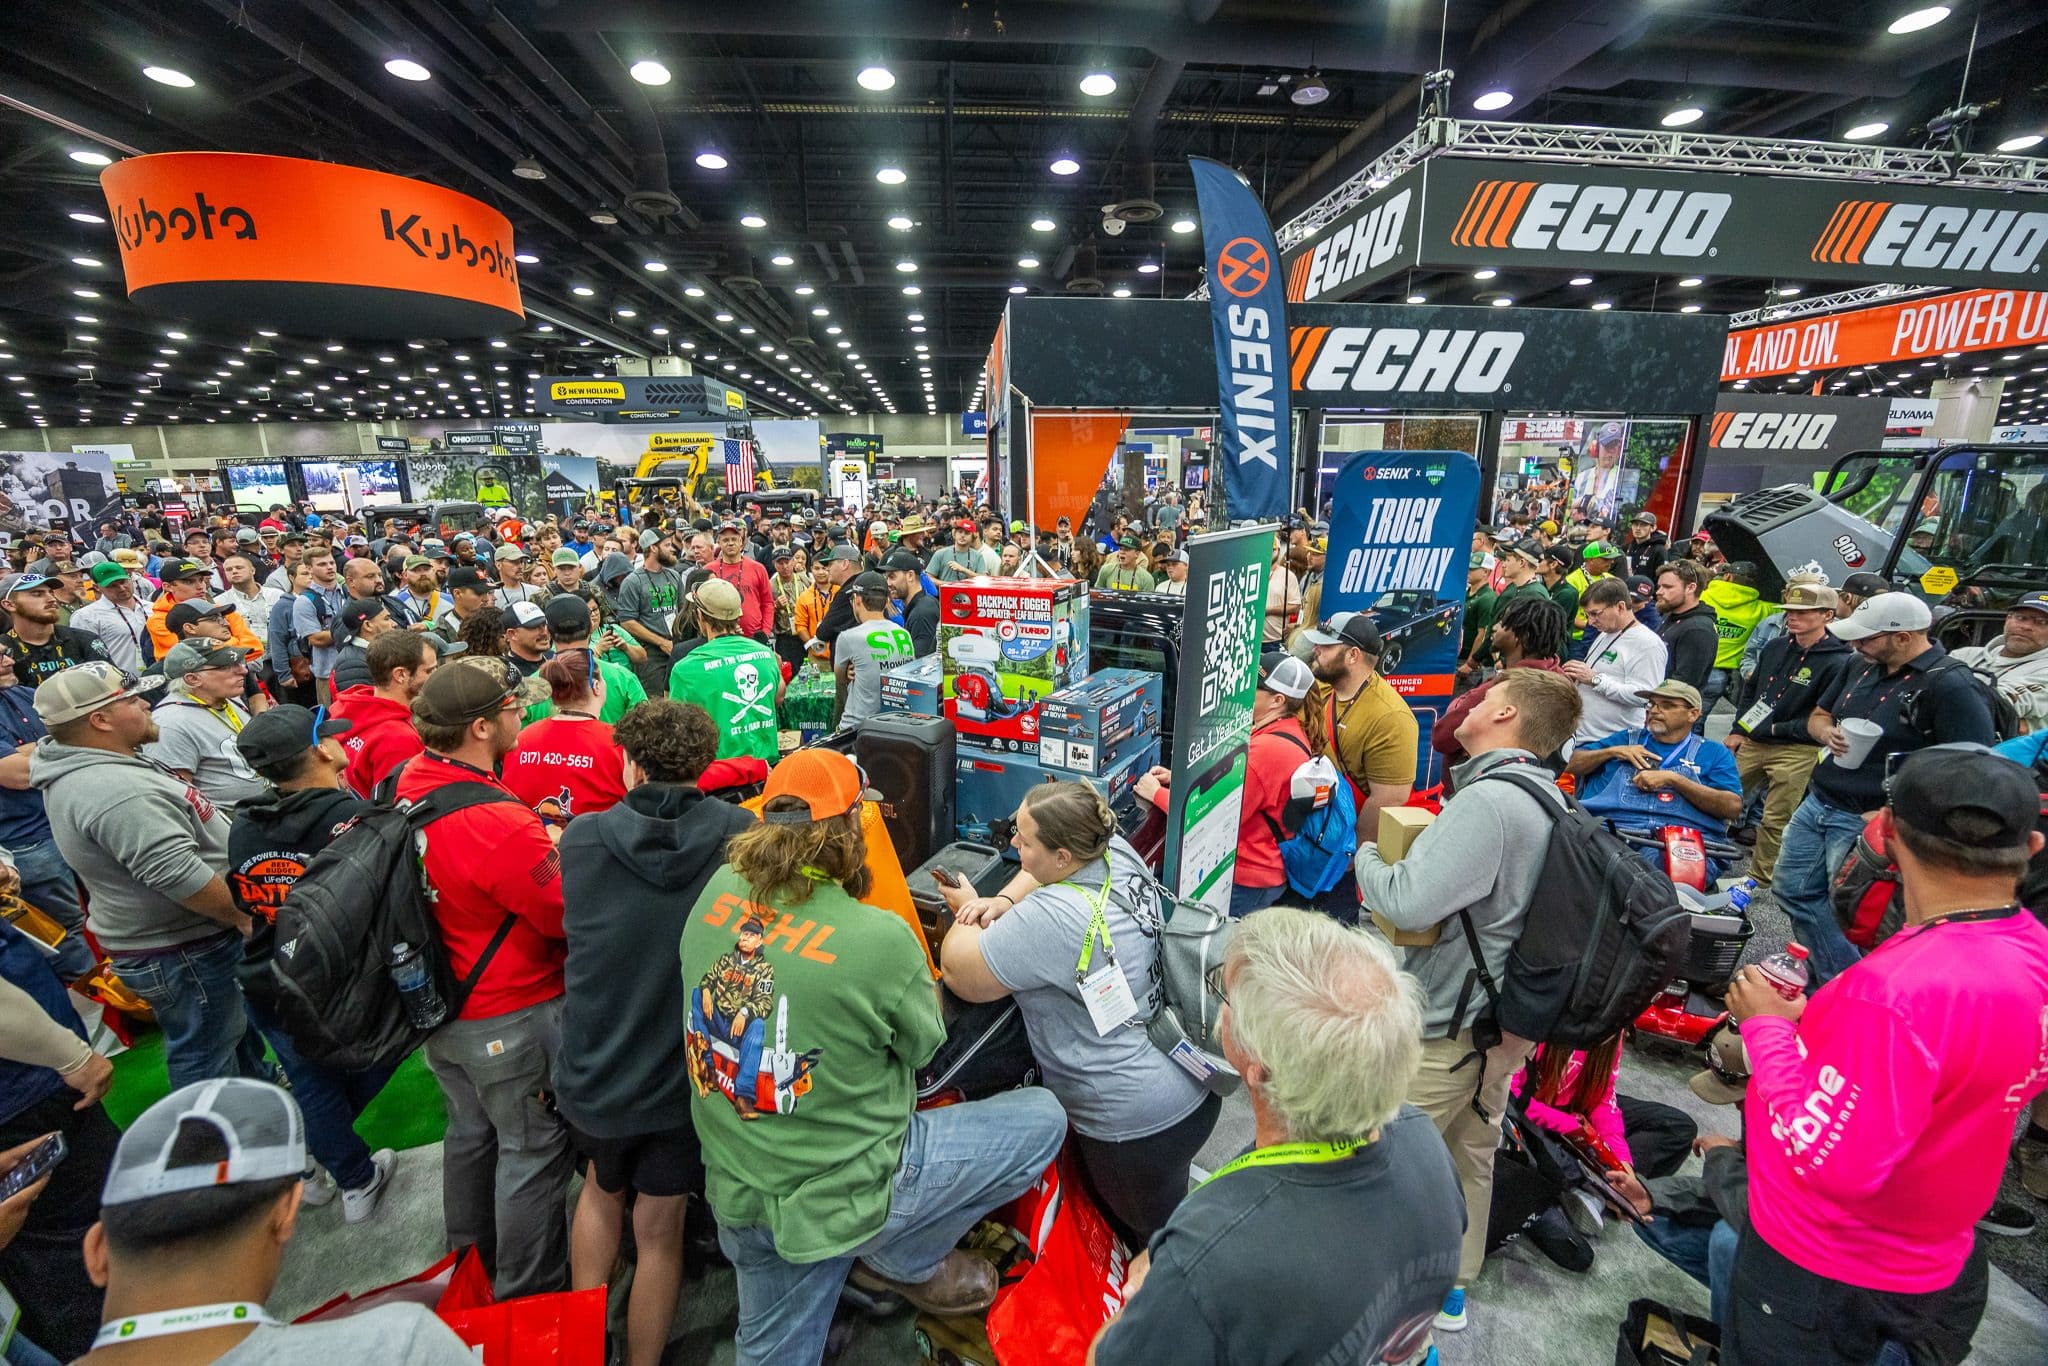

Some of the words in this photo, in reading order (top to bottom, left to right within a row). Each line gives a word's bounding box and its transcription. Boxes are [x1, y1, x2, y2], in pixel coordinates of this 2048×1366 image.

[112, 192, 257, 251] Kubota
[1511, 183, 1732, 257] ECHO
[1862, 203, 2048, 274] ECHO
[380, 208, 516, 285] Kubota
[1304, 187, 1412, 301] ECHO
[1891, 290, 2011, 356] POWER
[1305, 326, 1525, 393] ECHO
[1745, 328, 1796, 374] AND
[1798, 320, 1839, 372] ON.
[1228, 303, 1278, 470] SENIX
[1719, 412, 1837, 450] ECHO
[412, 463, 448, 472] Kubota
[1375, 467, 1411, 480] SENIX
[18, 498, 93, 522] FOR
[1363, 498, 1442, 545] TRUCK
[1339, 547, 1455, 594] GIVEAWAY
[1833, 534, 1863, 563] 906
[976, 595, 1018, 609] BACKPACK
[1019, 597, 1051, 612] FOGGER
[1020, 626, 1050, 635] TURBO
[888, 677, 908, 689] SENIX
[1048, 703, 1067, 714] SENIX
[519, 751, 541, 765] (317)
[543, 752, 594, 769] 420-5651
[1188, 736, 1205, 763] Get
[1207, 730, 1213, 750] 1
[1216, 719, 1234, 743] Year
[251, 850, 281, 864] POWER.
[240, 883, 292, 904] BATT
[1811, 1083, 1864, 1171] anagement
